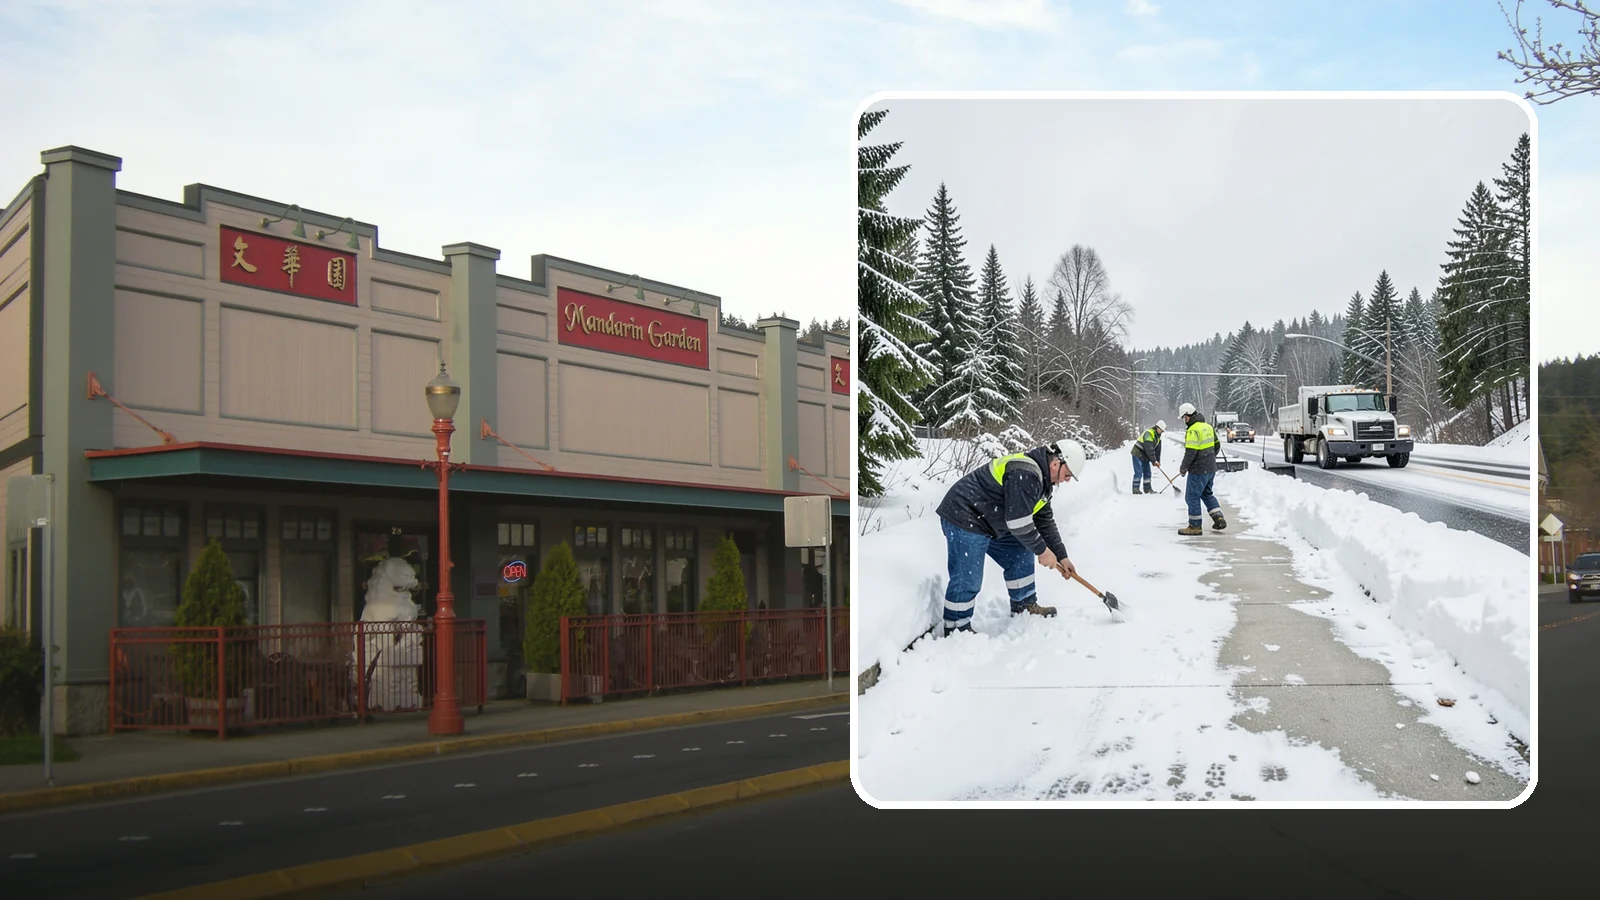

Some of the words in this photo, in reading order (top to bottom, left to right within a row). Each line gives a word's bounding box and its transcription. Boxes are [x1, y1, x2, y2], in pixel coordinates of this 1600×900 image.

[231, 236, 346, 290] 文華園
[564, 302, 644, 341] Mandarin
[647, 320, 701, 352] Garden
[503, 565, 527, 578] OPEN
